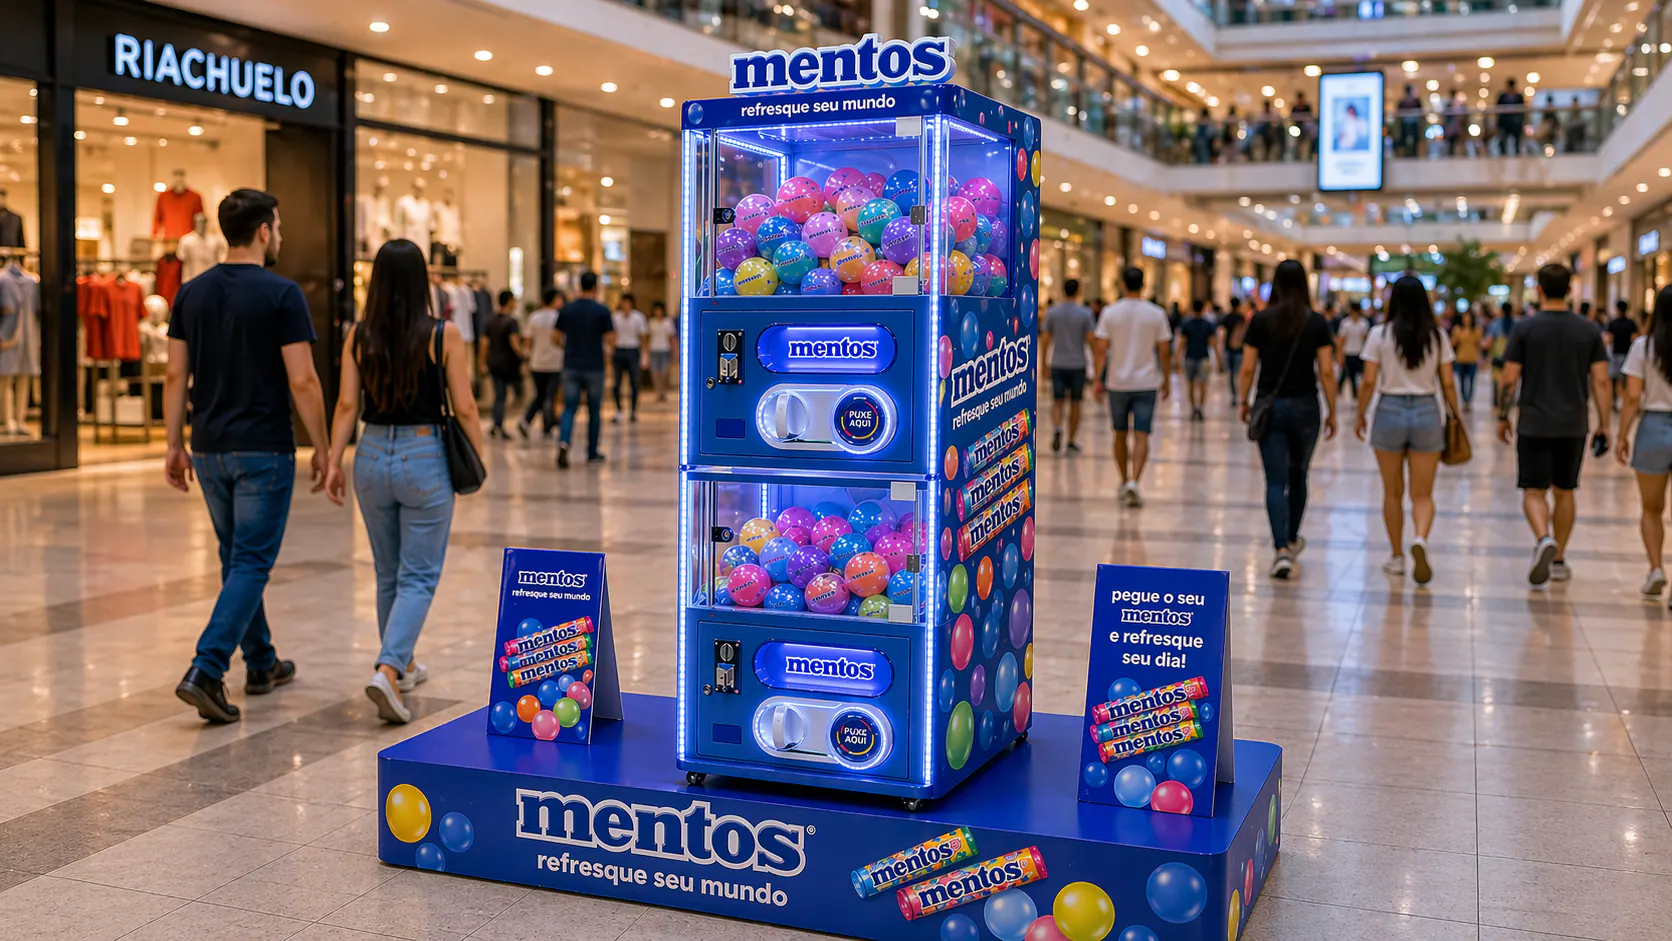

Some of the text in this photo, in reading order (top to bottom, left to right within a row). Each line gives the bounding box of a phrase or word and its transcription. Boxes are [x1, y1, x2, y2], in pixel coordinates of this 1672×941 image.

[114, 33, 316, 109] RIACHUELO
[731, 34, 953, 93] mentos
[740, 94, 896, 118] refresque seu mundo
[789, 337, 878, 358] mentos
[951, 335, 1030, 408] mentos
[849, 411, 872, 419] PUXE
[952, 379, 1027, 430] refresque seu mundo
[849, 420, 871, 428] AQUI
[973, 423, 1020, 465] mentos
[970, 458, 1020, 506] mentos
[970, 495, 1021, 547] mentos
[518, 570, 587, 588] mentos
[512, 588, 548, 599] refresque
[564, 593, 591, 601] mundo
[1111, 590, 1205, 605] pegue o seu
[1121, 608, 1193, 627] mentos
[1109, 629, 1204, 650] e refresque
[786, 657, 875, 680] mentos
[1122, 652, 1186, 668] seu dia!
[1108, 687, 1187, 719] mentos
[844, 727, 867, 736] PUXE
[1111, 709, 1182, 738] mentos
[845, 736, 867, 744] AQUI
[1113, 728, 1184, 754] mentos
[515, 787, 808, 877] mentos
[870, 841, 953, 888] mentos
[537, 852, 788, 908] refresque seu mundo
[918, 859, 1023, 909] mentos
